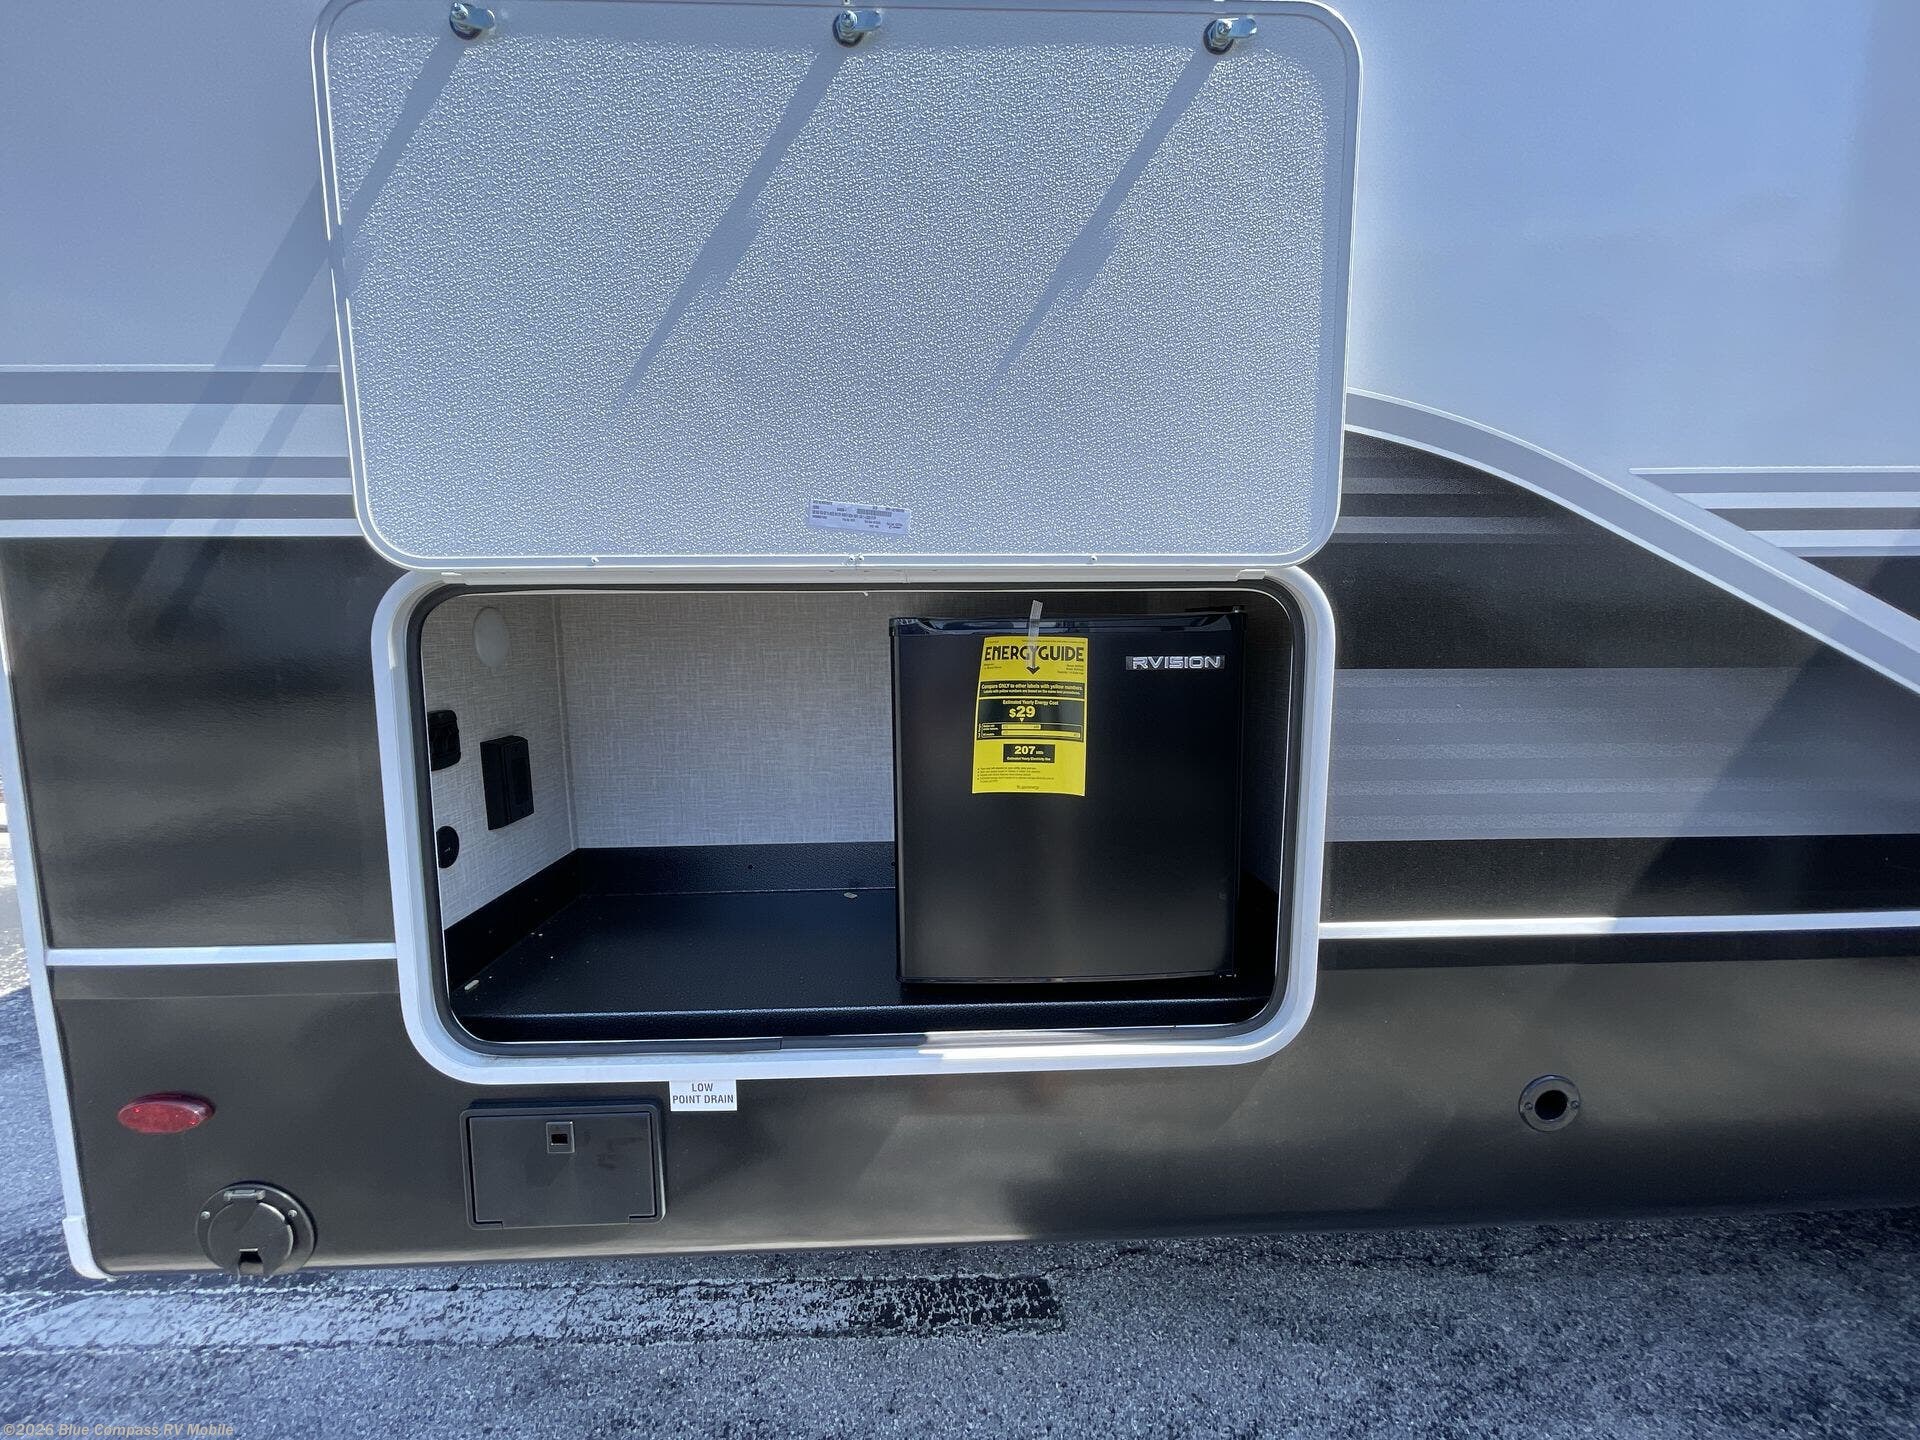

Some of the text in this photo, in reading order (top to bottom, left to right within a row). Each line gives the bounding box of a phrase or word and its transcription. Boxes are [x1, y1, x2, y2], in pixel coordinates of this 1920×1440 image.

[985, 645, 1084, 662] ENERGYGUIDE
[1132, 656, 1221, 669] RVISION
[1009, 705, 1036, 718] $29
[1014, 745, 1036, 755] 207
[692, 1083, 713, 1092] LOW
[673, 1094, 734, 1104] POINT DRAIN
